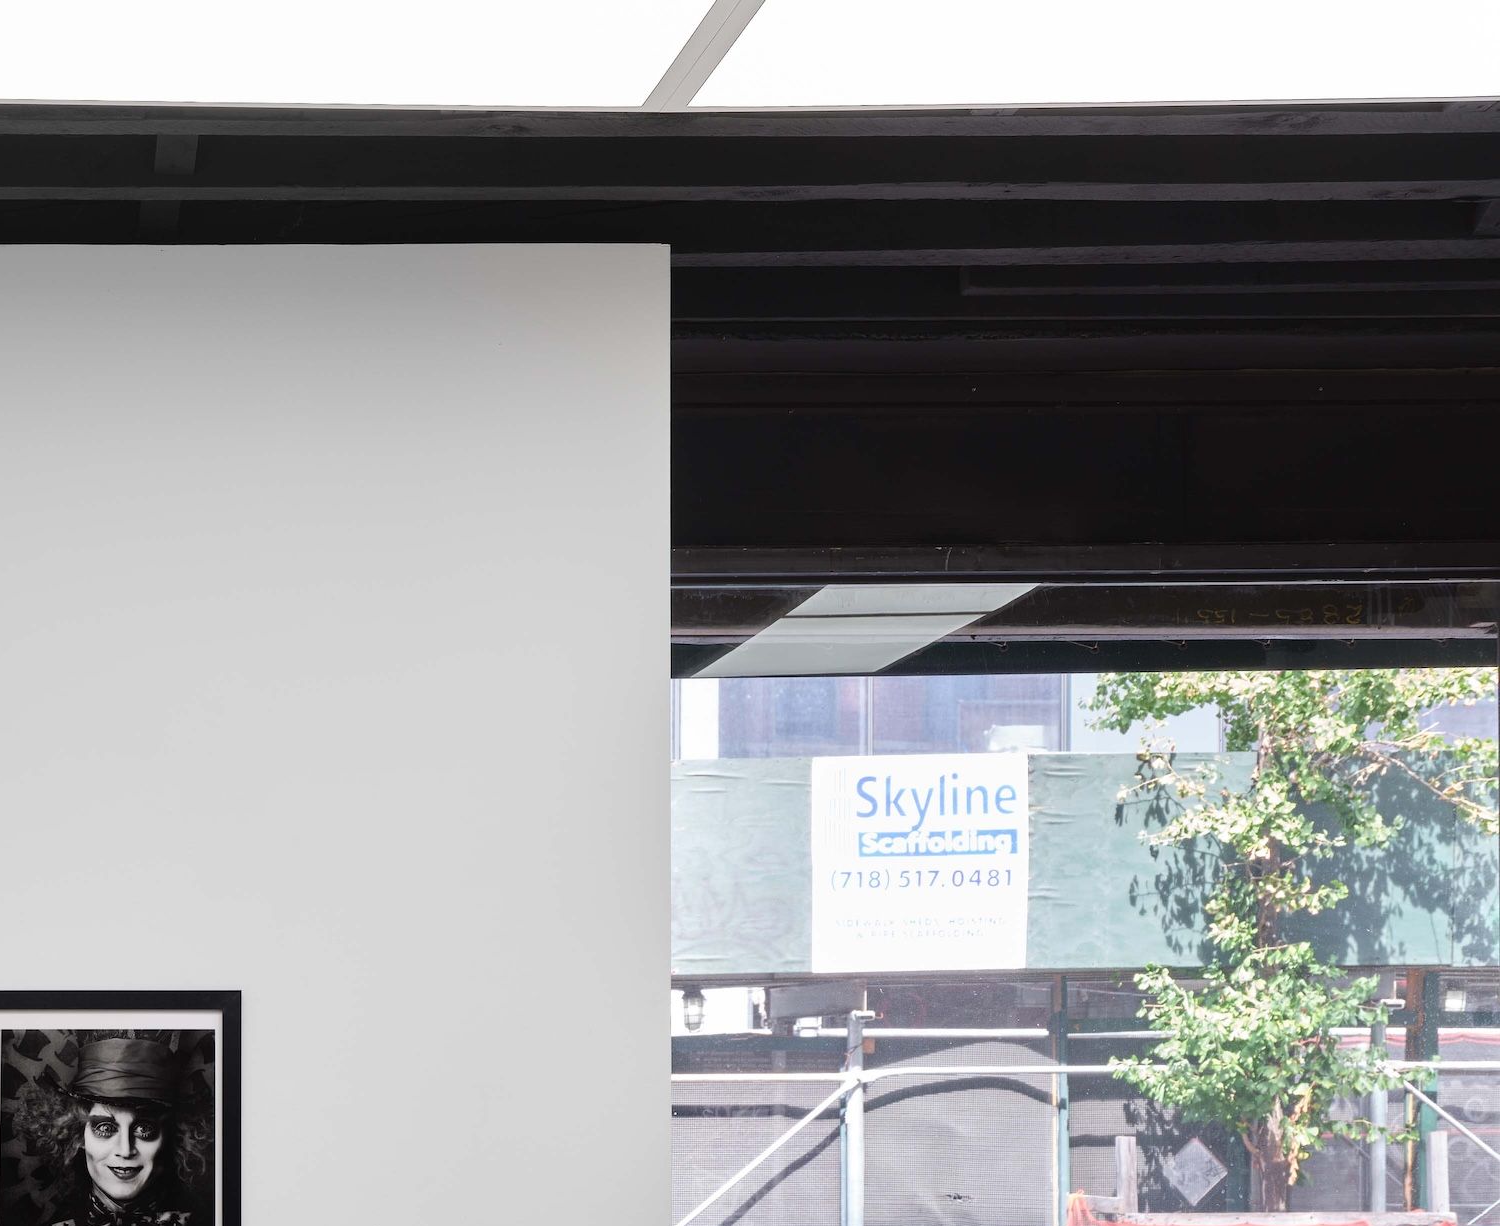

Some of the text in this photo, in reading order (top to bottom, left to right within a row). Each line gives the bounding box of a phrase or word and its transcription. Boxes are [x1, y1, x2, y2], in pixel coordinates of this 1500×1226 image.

[856, 773, 1017, 831] Skyline
[860, 830, 1013, 855] Scaffolding
[831, 869, 1012, 890] (718) 517.0481
